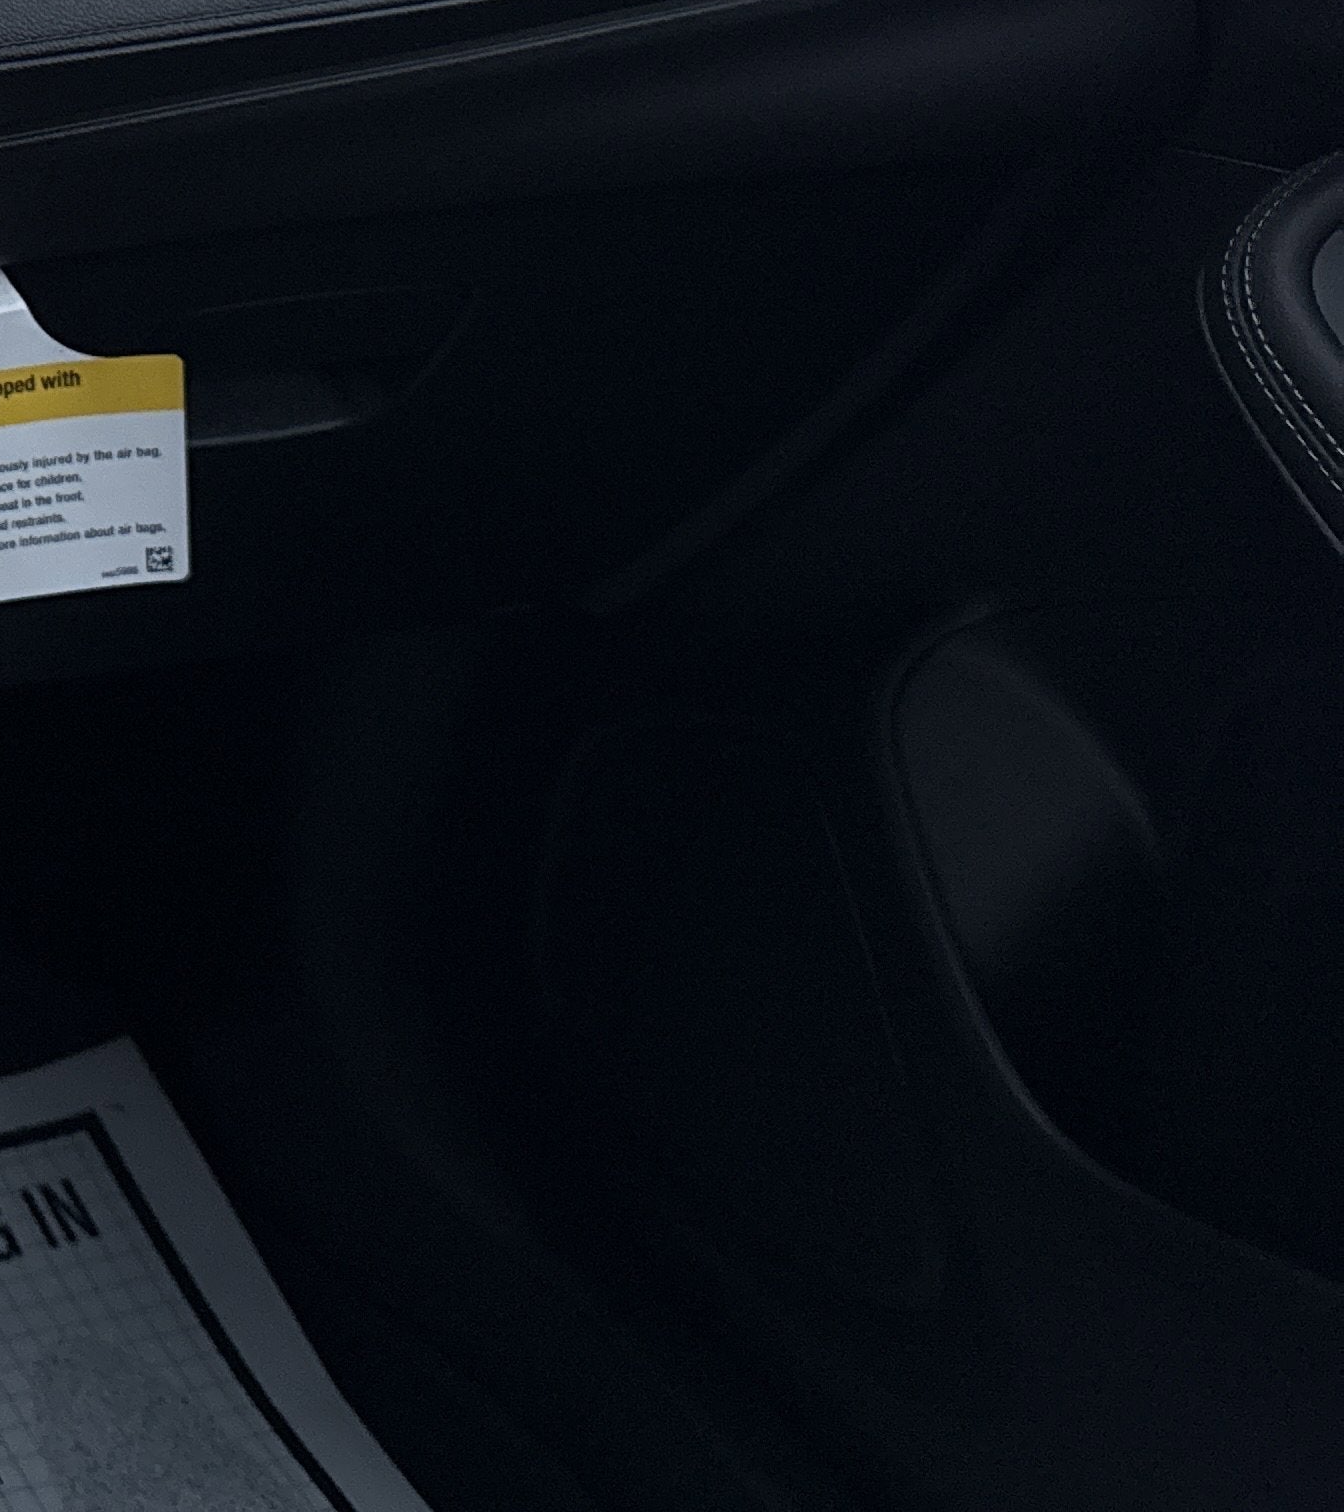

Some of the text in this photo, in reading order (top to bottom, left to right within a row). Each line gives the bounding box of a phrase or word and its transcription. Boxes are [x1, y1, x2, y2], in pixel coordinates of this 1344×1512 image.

[40, 369, 81, 390] with
[32, 453, 73, 469] injured
[93, 449, 112, 461] the
[21, 1178, 100, 1249] IN
